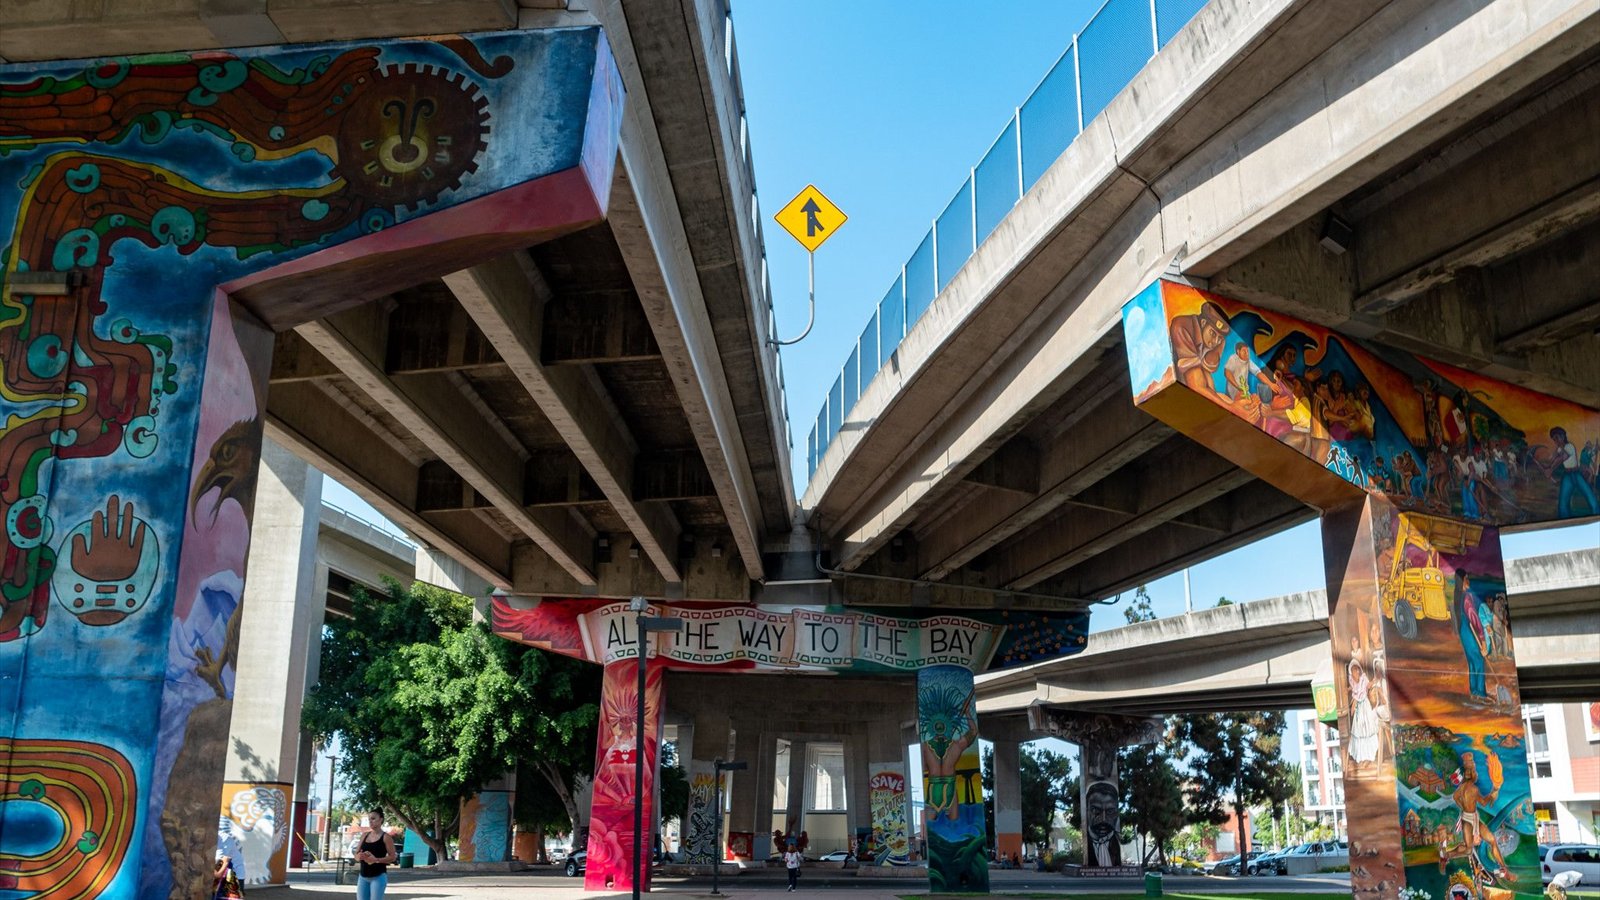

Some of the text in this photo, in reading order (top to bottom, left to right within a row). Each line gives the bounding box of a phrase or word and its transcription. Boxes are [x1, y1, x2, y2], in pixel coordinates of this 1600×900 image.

[607, 616, 653, 650] AL
[738, 619, 786, 652] WAY
[805, 622, 839, 653] TO
[858, 621, 909, 657] THE
[930, 628, 979, 656] BAY
[689, 783, 713, 801] WHY
[871, 775, 904, 791] SAVE
